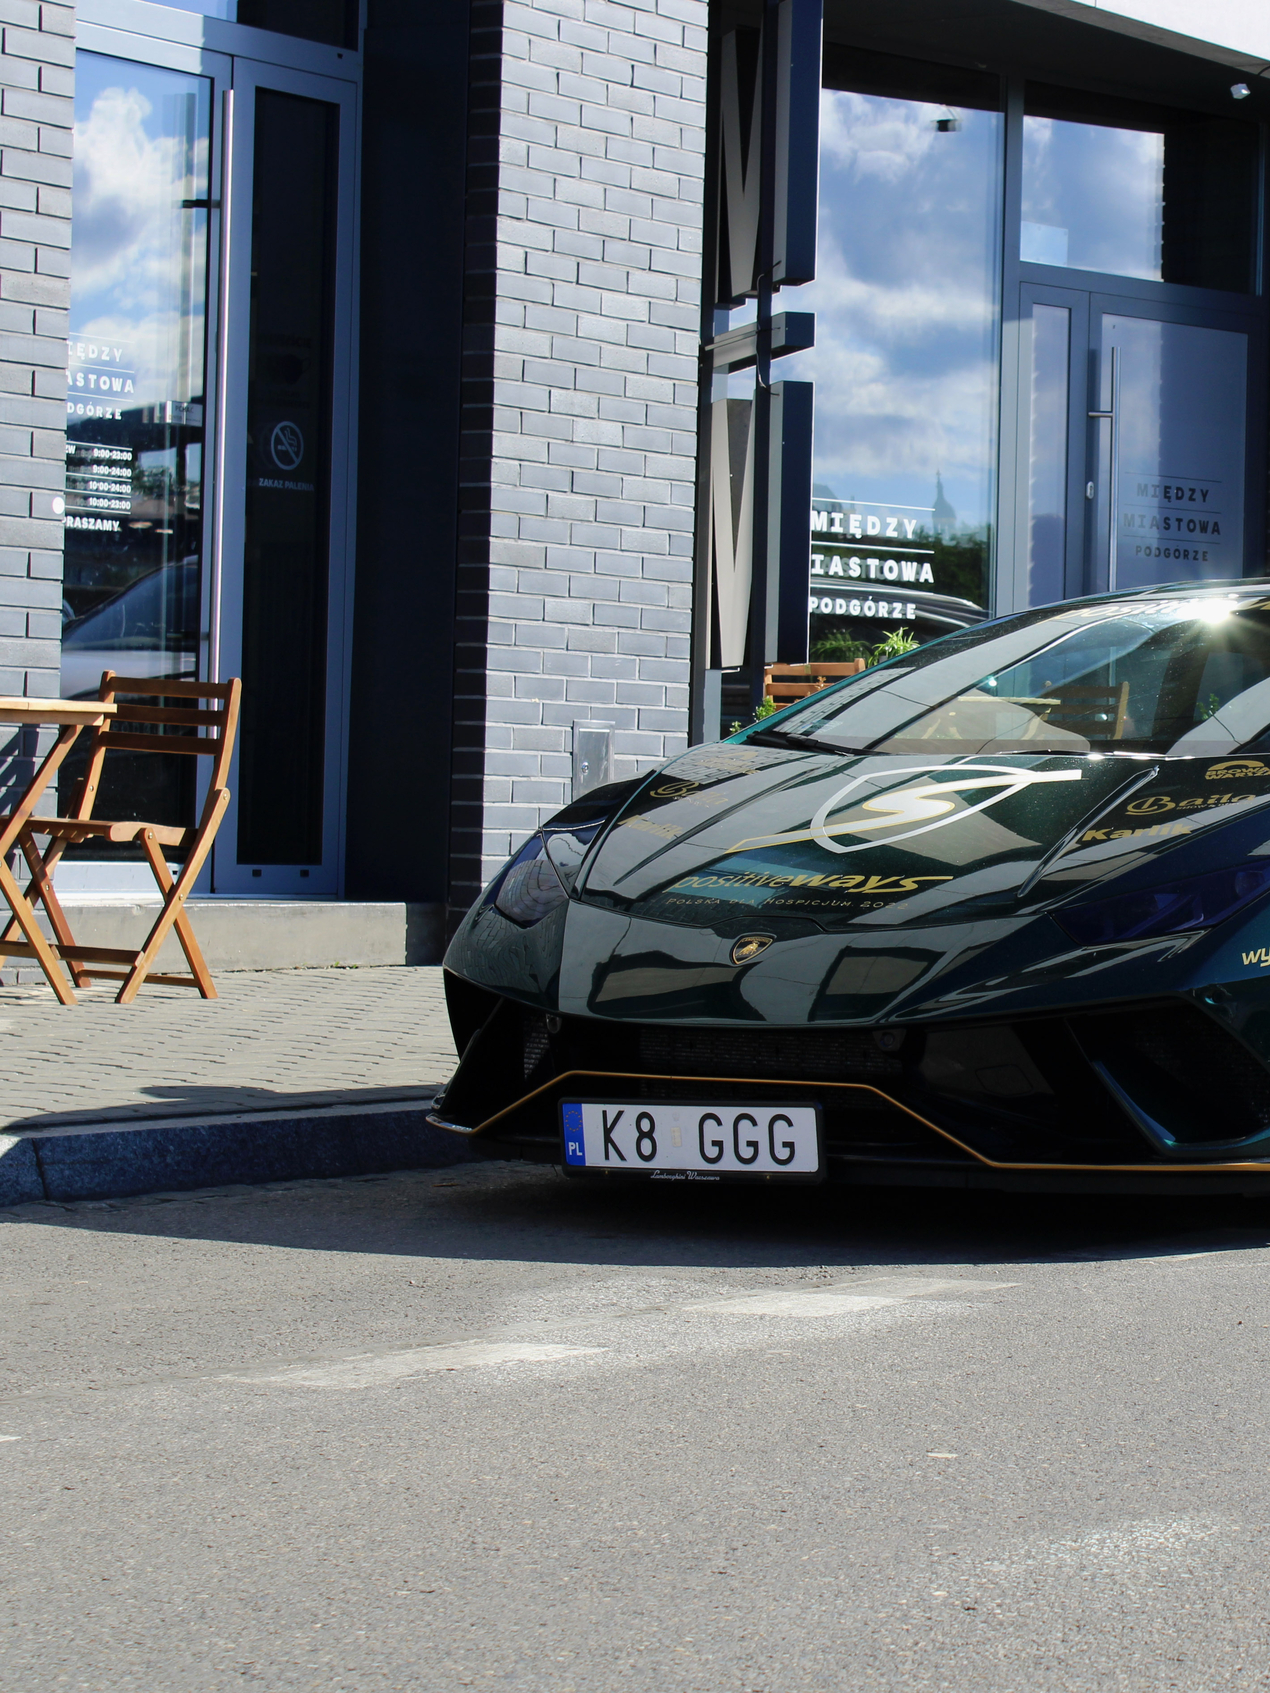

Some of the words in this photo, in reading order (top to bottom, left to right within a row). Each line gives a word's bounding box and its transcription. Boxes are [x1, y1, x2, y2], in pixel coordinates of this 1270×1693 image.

[258, 477, 283, 489] ZAKAZ
[284, 480, 314, 491] PALENIA
[1136, 483, 1209, 503] MIĘDZY
[811, 510, 917, 539] MIĘDZY
[1123, 513, 1221, 535] MIASTOWA
[1135, 544, 1208, 562] PODGÓRZE
[809, 595, 916, 620] PODGÓRZE
[1082, 823, 1193, 841] Karlik
[602, 1109, 658, 1162] K8
[698, 1112, 796, 1166] GGG
[568, 1142, 583, 1156] PL
[650, 1170, 686, 1182] Lamborghini
[687, 1170, 721, 1182] Warszawa
